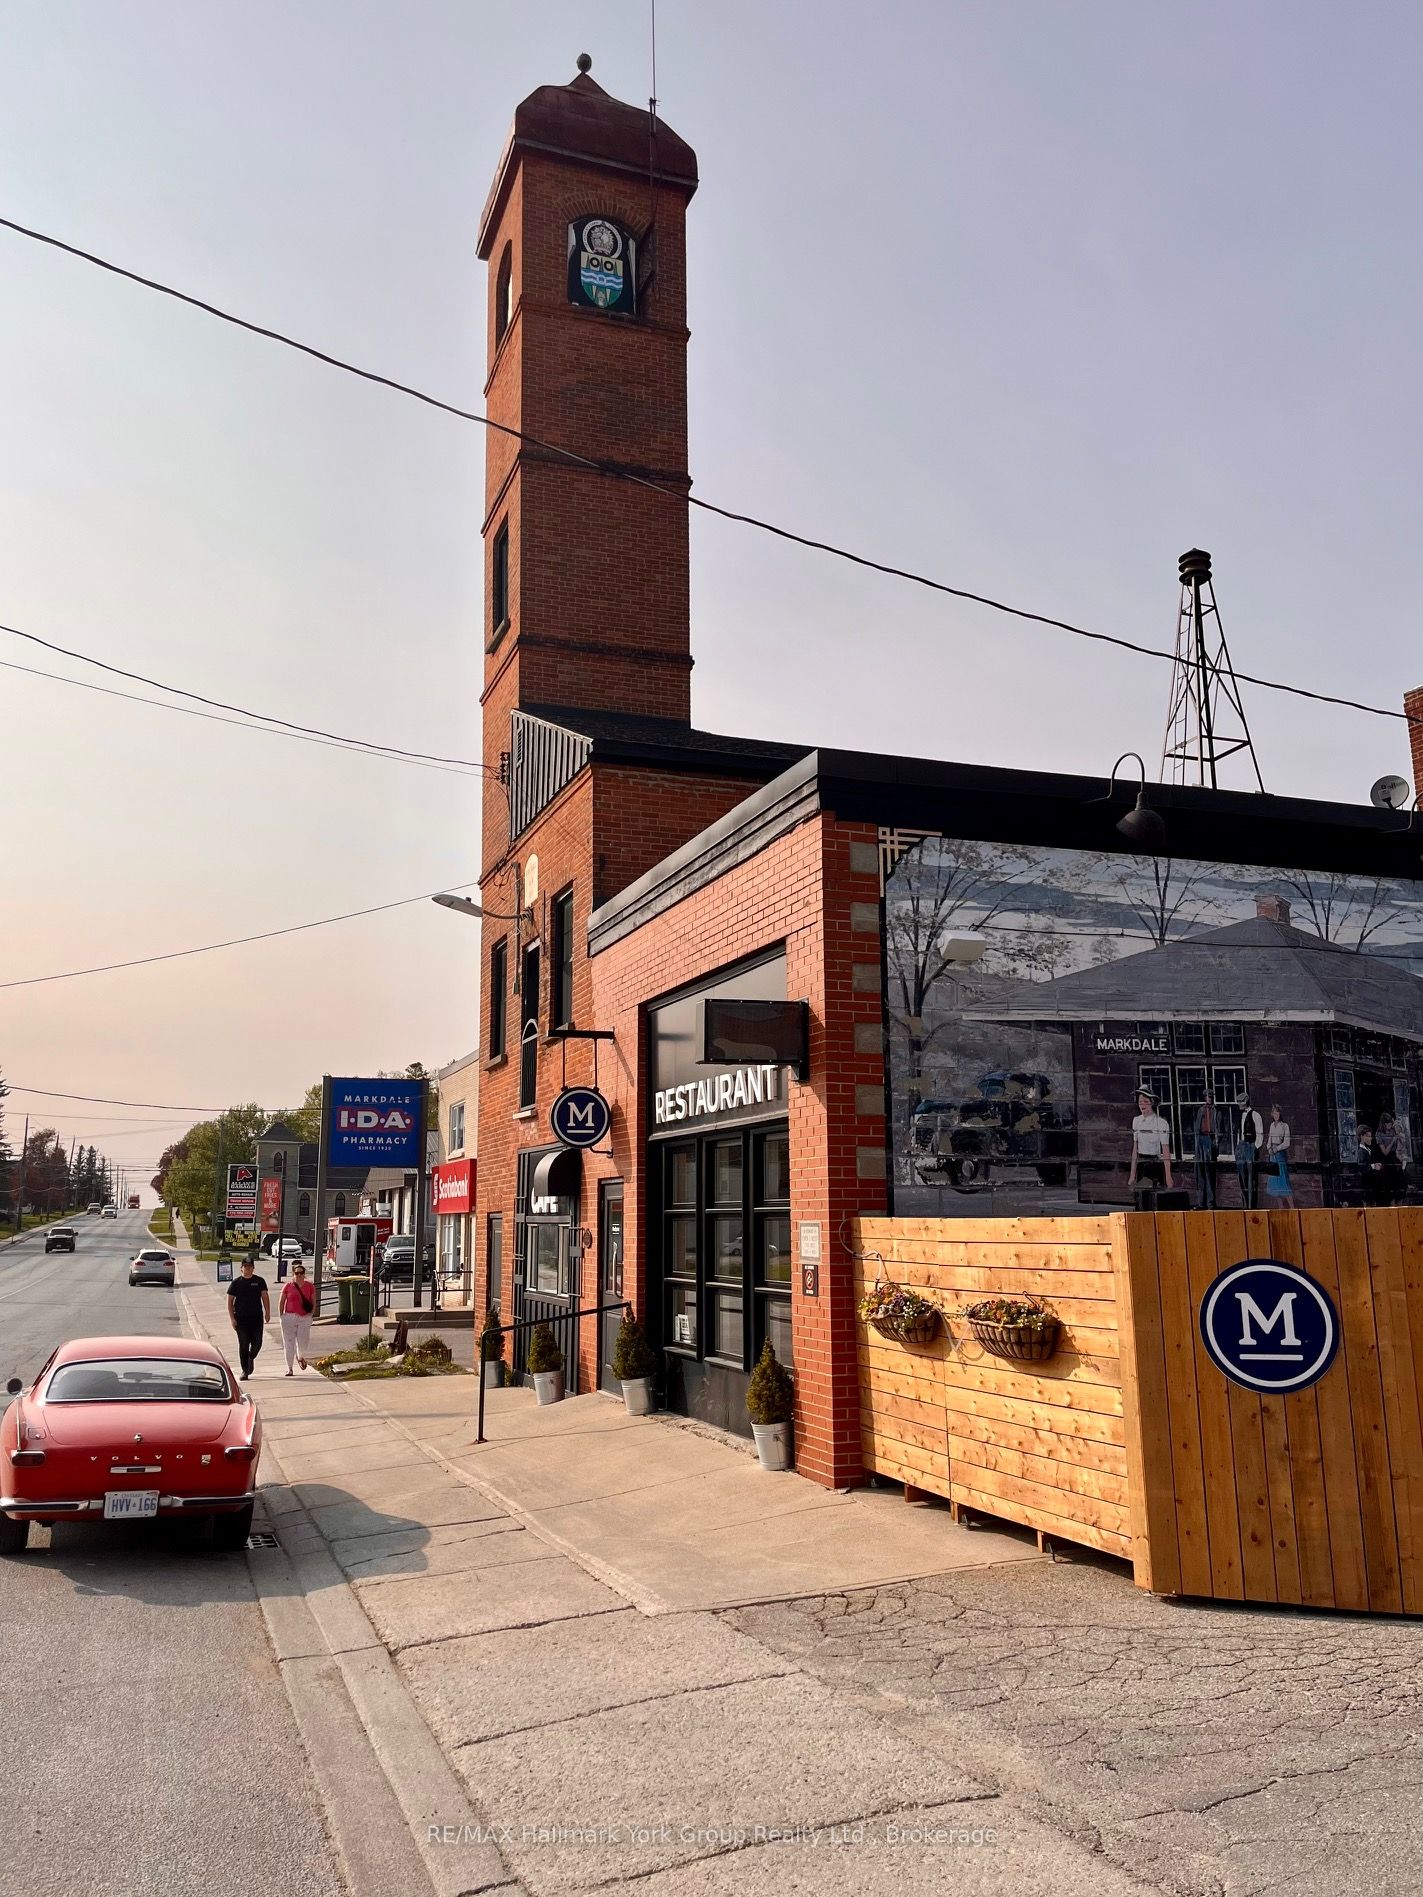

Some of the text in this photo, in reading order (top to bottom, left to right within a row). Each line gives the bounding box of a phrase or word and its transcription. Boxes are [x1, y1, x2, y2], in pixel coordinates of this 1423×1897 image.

[1097, 1038, 1168, 1051] MARKDALE
[344, 1095, 410, 1104] MARKDALE
[655, 1064, 779, 1124] RESTAURANT
[567, 1102, 595, 1127] M
[342, 1136, 408, 1145] PHARMACY
[438, 1172, 469, 1199] Scotiabank
[1234, 1292, 1302, 1346] M
[138, 1497, 157, 1511] 166
